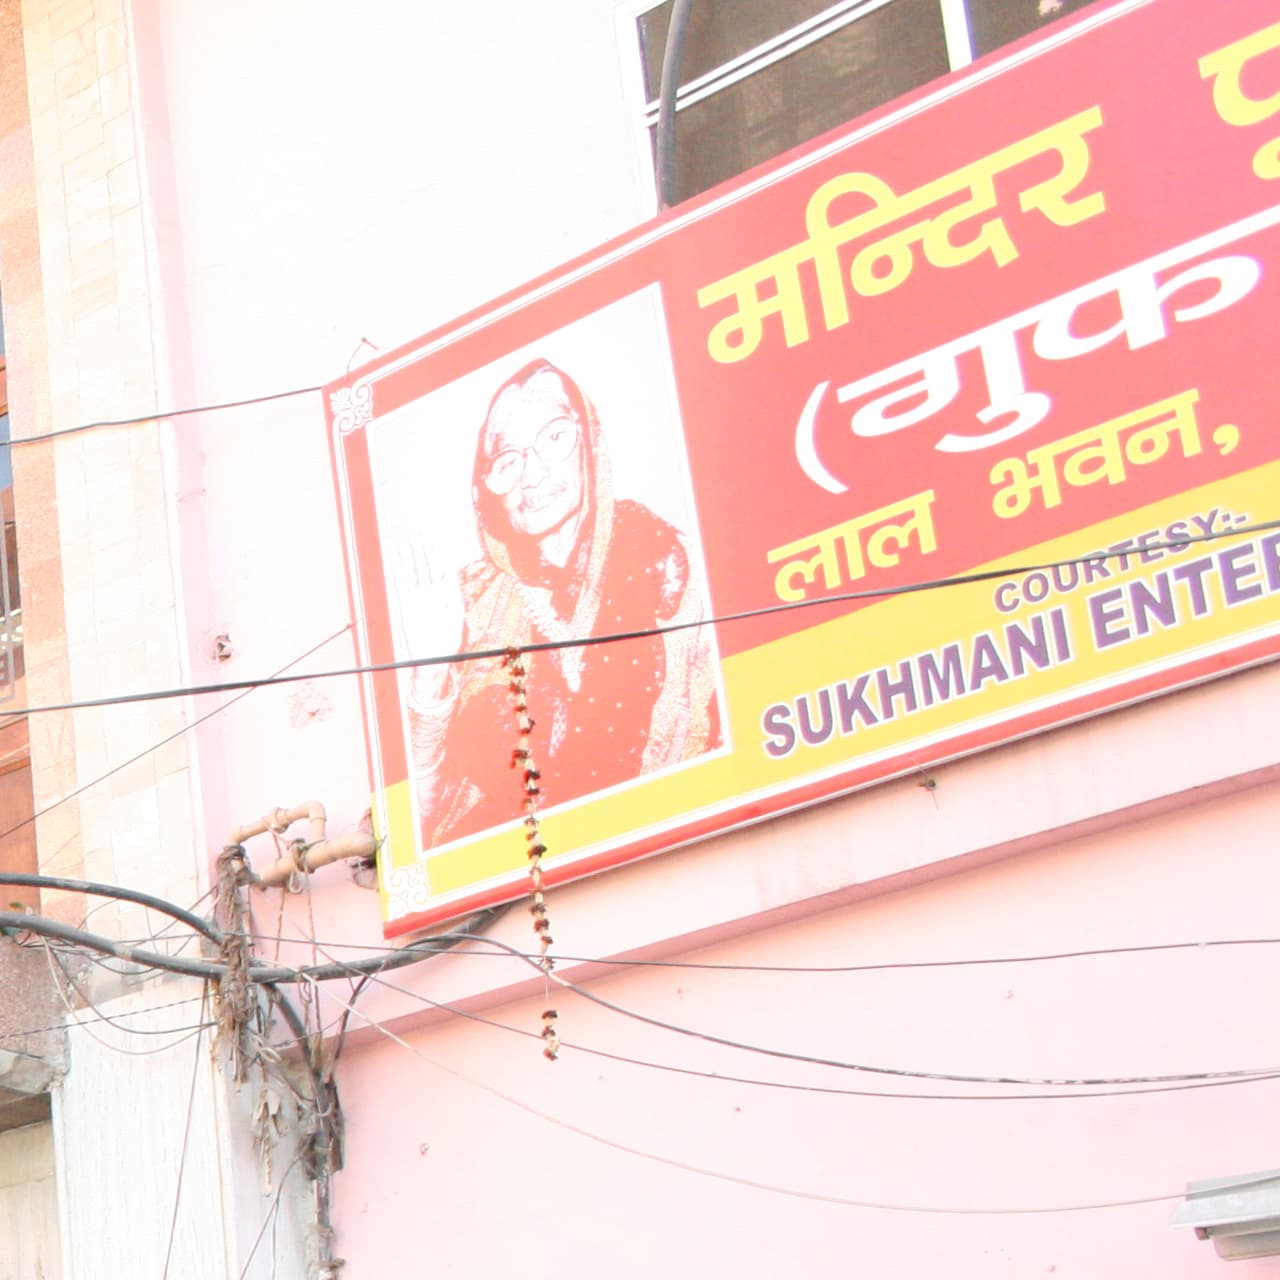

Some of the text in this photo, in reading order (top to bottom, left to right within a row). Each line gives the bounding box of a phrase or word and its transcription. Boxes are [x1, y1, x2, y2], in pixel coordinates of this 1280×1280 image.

[696, 105, 1107, 364] मन्दिर
[767, 388, 1240, 602] लाल भवन,
[761, 607, 1072, 758] SUKHMANI
